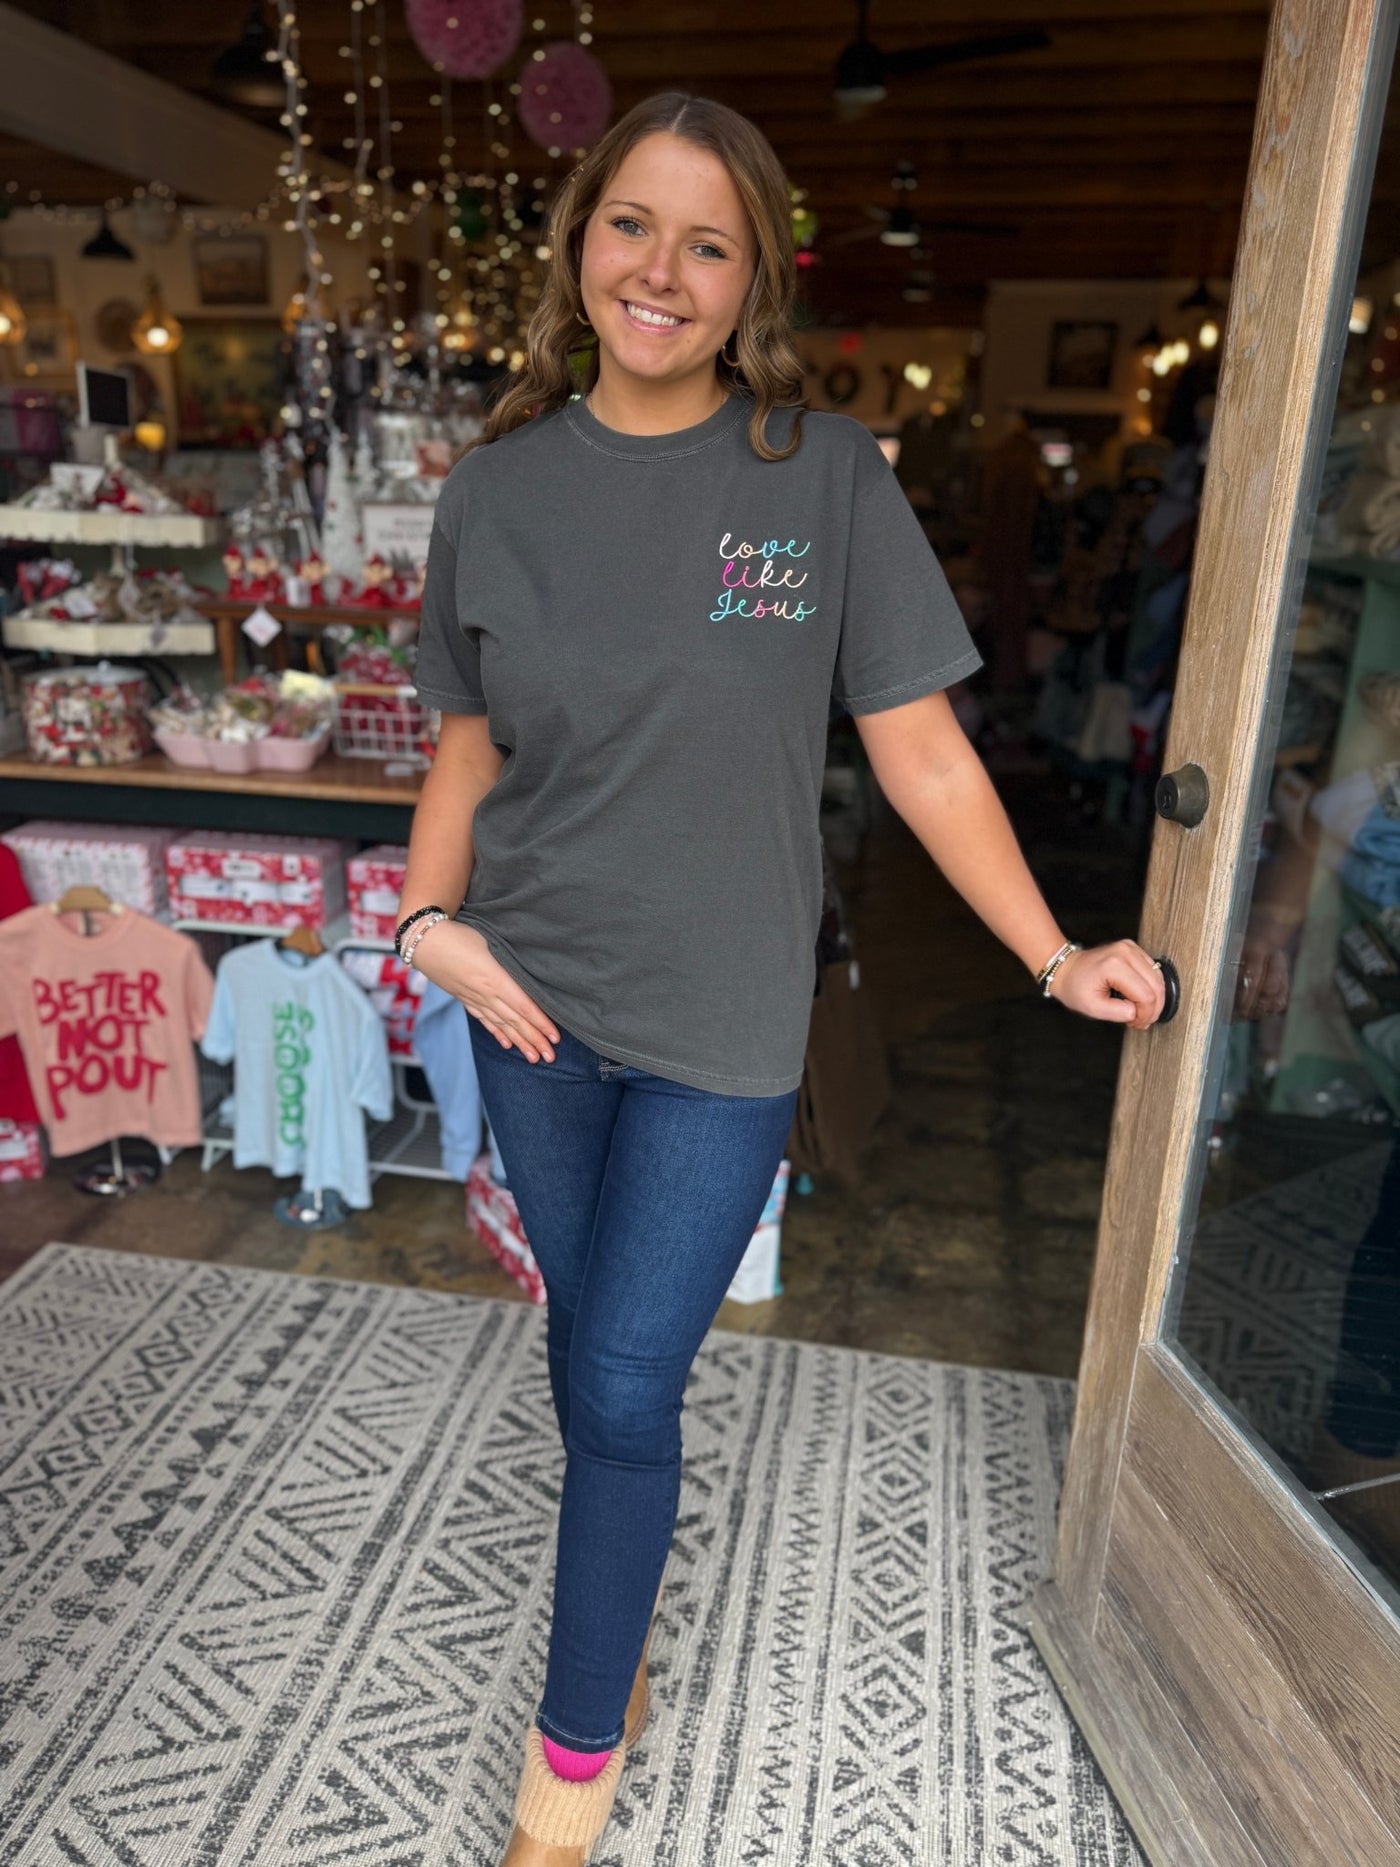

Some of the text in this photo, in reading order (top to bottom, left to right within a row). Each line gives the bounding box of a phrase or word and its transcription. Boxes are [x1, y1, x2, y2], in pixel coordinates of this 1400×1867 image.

[719, 532, 811, 559] love
[722, 560, 808, 588] like
[709, 588, 817, 621] Jesus
[32, 971, 167, 1027] BETTER
[57, 1014, 150, 1062] NOT
[46, 1053, 168, 1121] POUT
